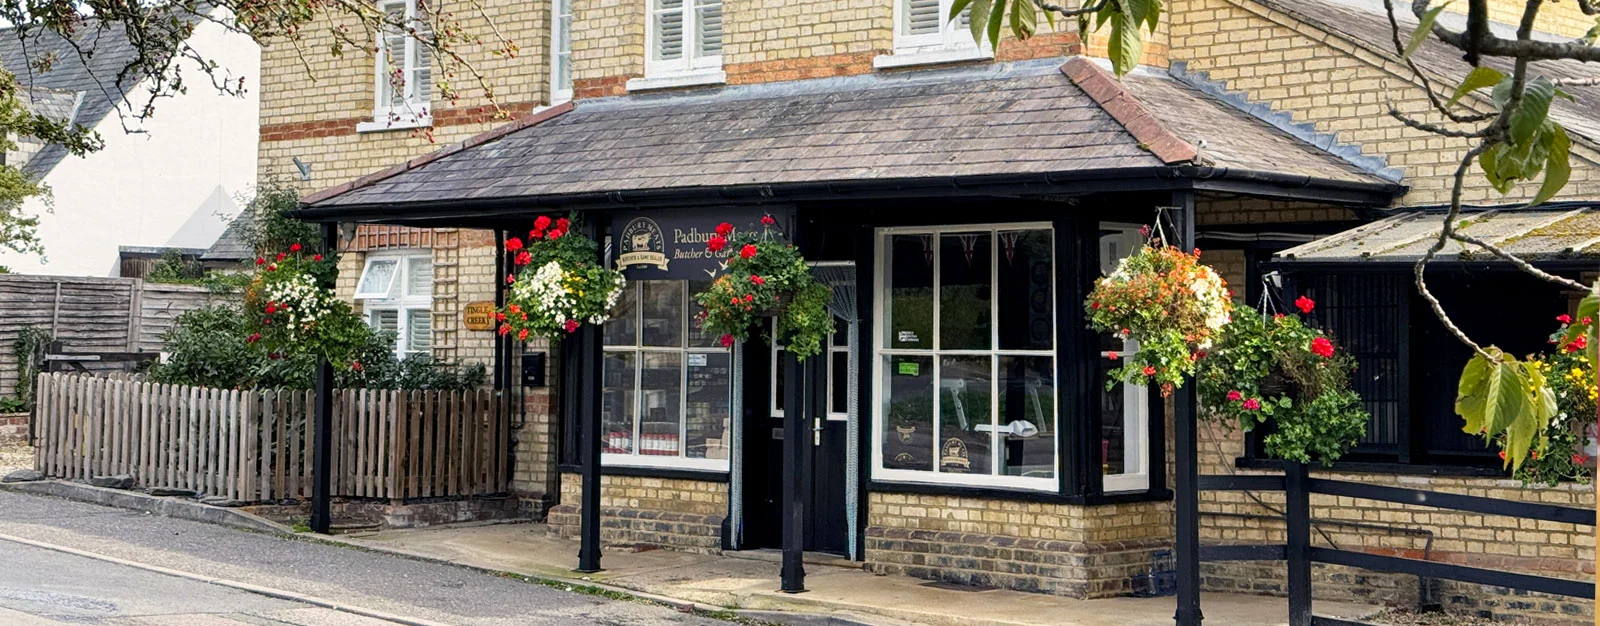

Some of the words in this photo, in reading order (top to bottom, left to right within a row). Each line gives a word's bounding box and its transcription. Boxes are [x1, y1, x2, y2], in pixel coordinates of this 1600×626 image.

[674, 228, 721, 243] Padbur
[674, 247, 703, 259] Butcher
[704, 247, 713, 259] &
[467, 306, 488, 314] TINGLE
[467, 316, 486, 325] CREEK
